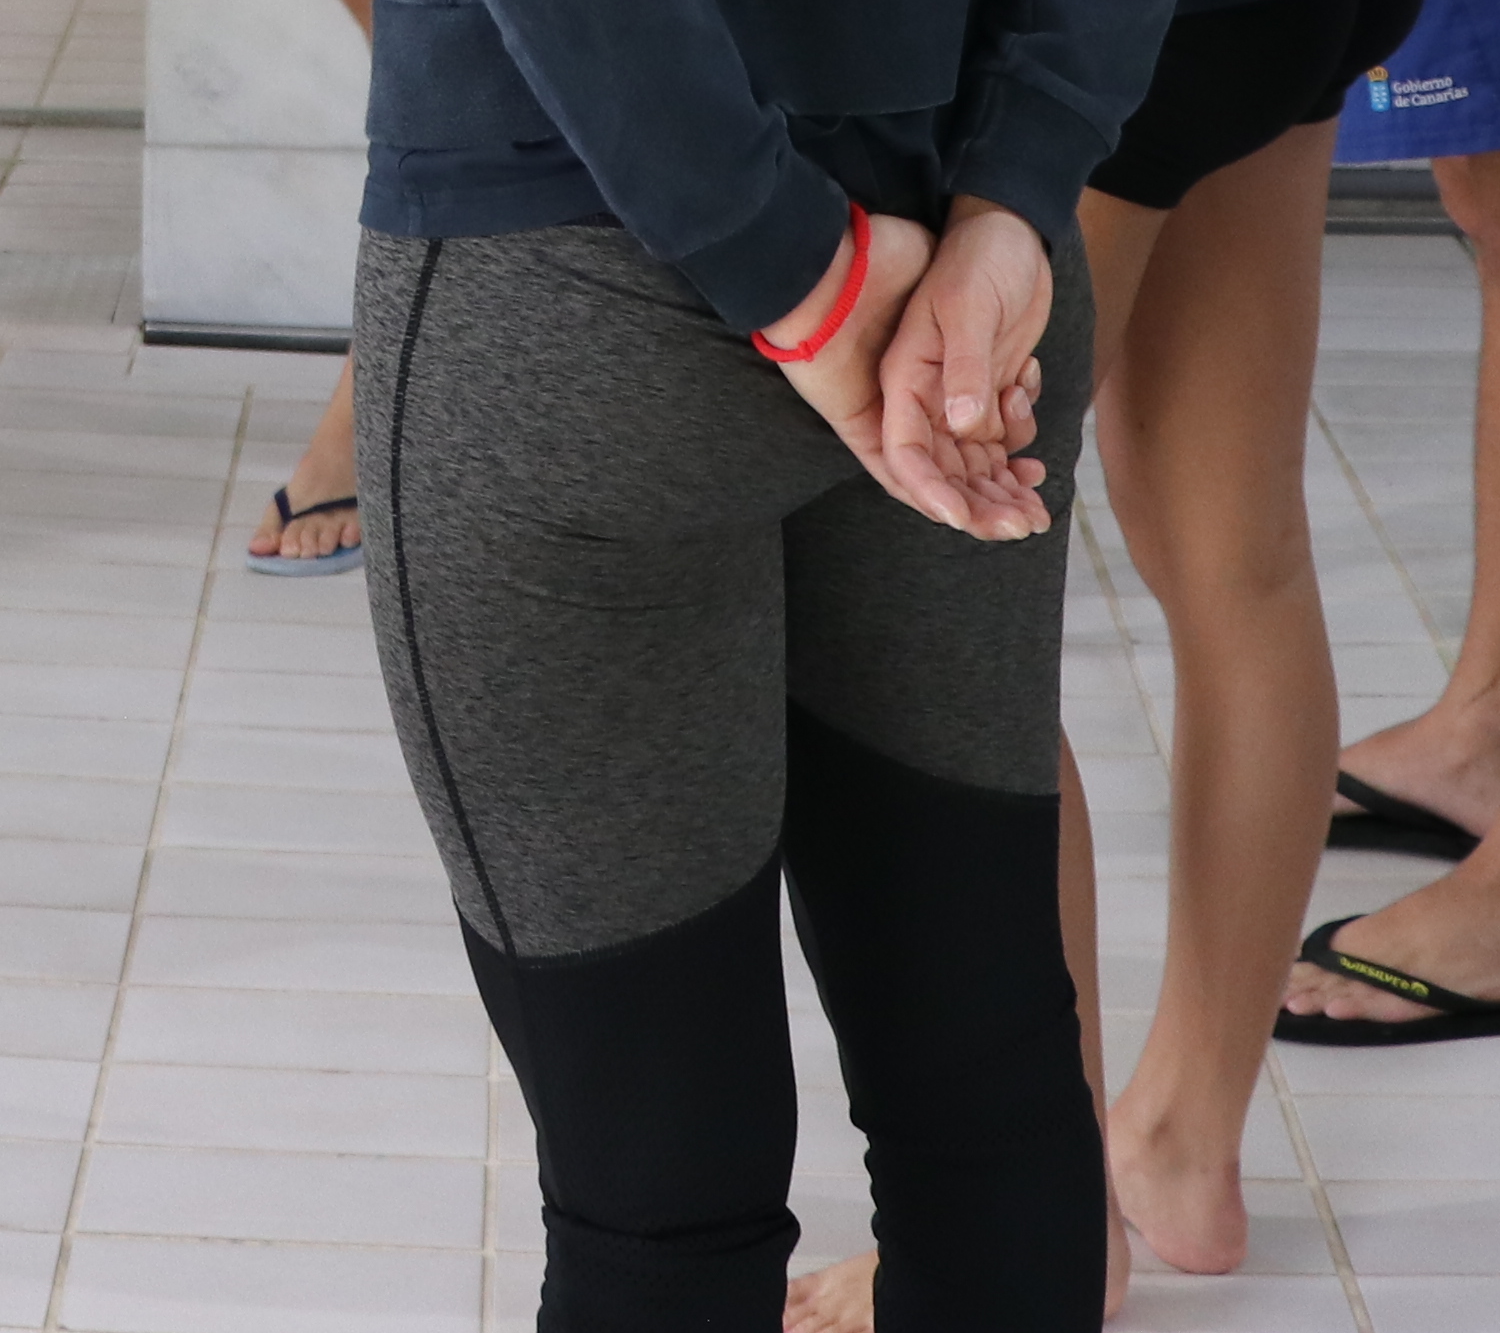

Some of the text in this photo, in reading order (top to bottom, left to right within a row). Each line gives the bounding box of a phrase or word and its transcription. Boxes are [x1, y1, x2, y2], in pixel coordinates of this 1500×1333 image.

[1393, 76, 1453, 93] Gobierno
[1394, 87, 1468, 108] de Canarias
